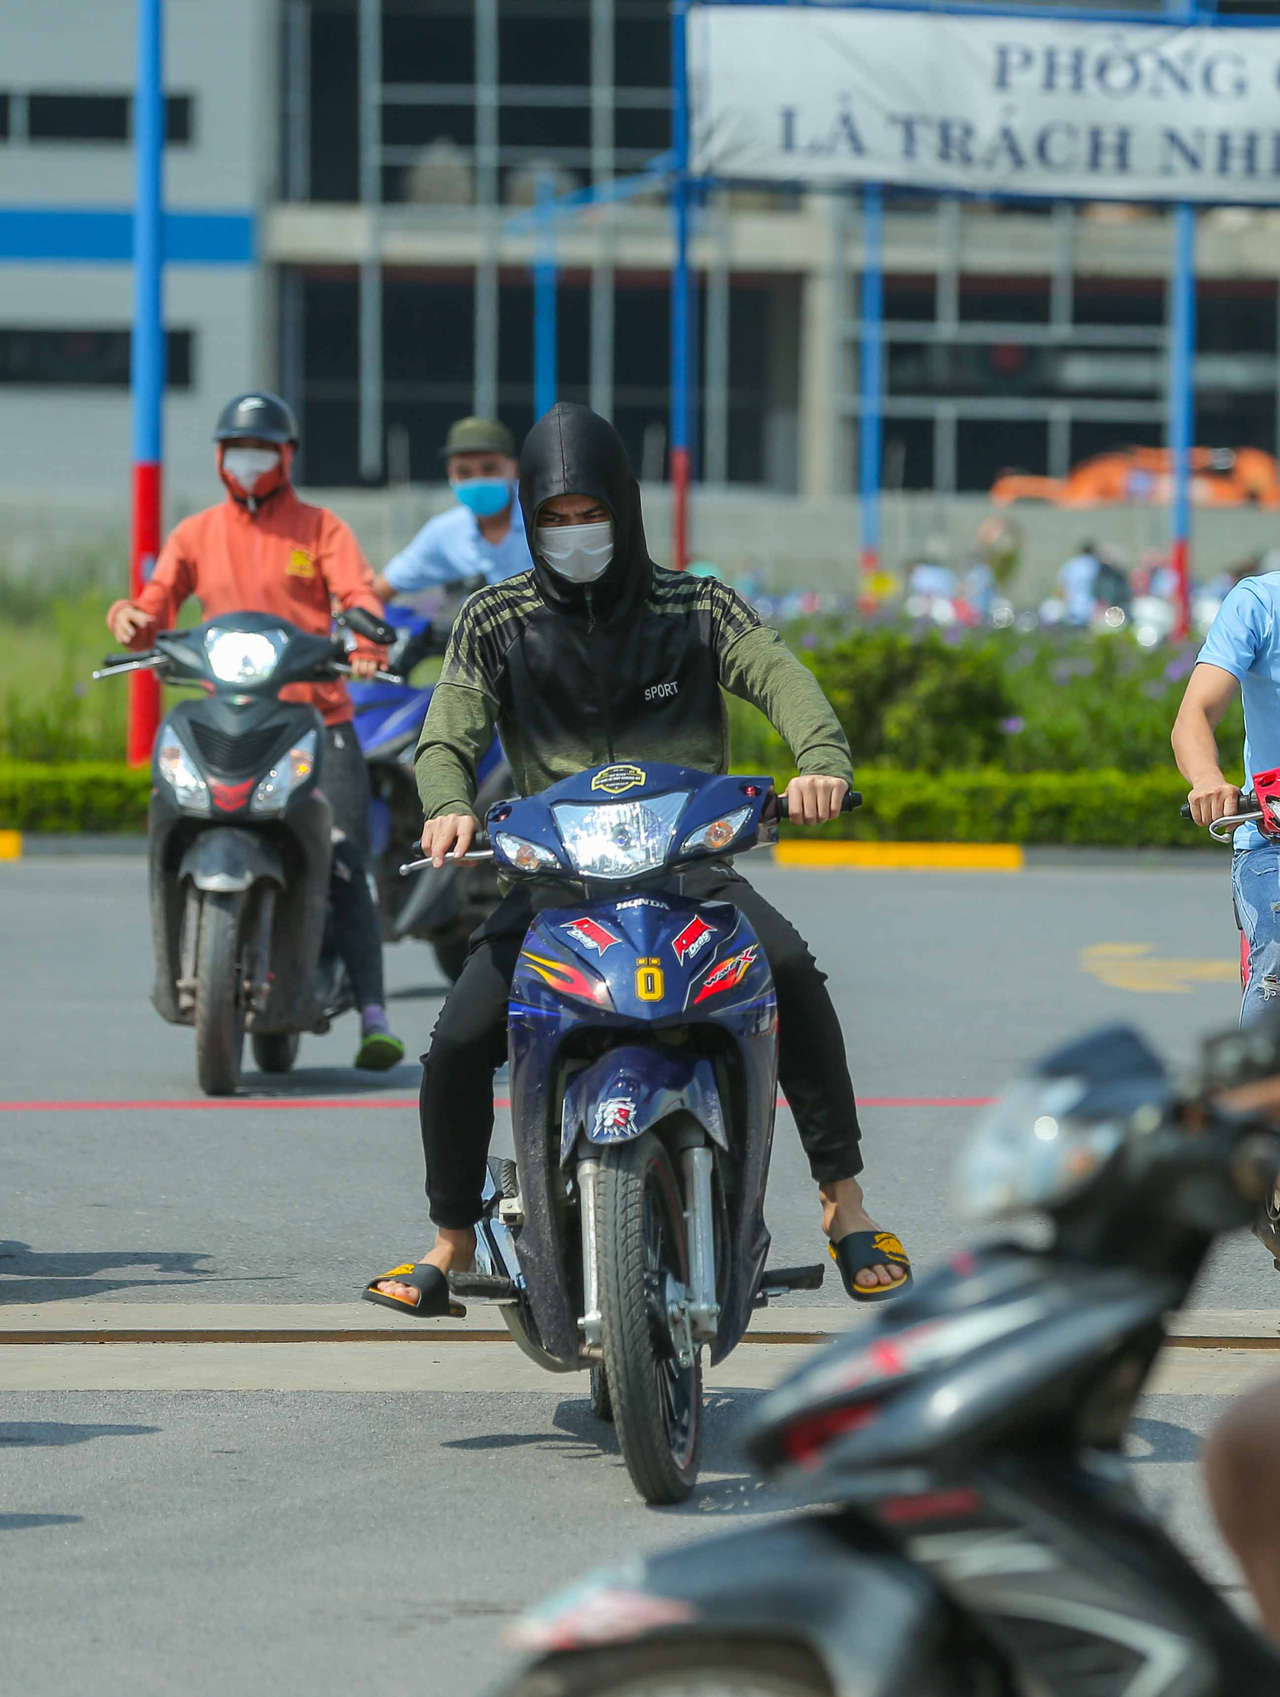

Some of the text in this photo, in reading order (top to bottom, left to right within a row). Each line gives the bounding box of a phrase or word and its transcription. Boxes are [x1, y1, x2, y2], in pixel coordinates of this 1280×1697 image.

[644, 681, 679, 701] SPORT
[615, 898, 670, 911] HONDA
[688, 930, 711, 958] Drag
